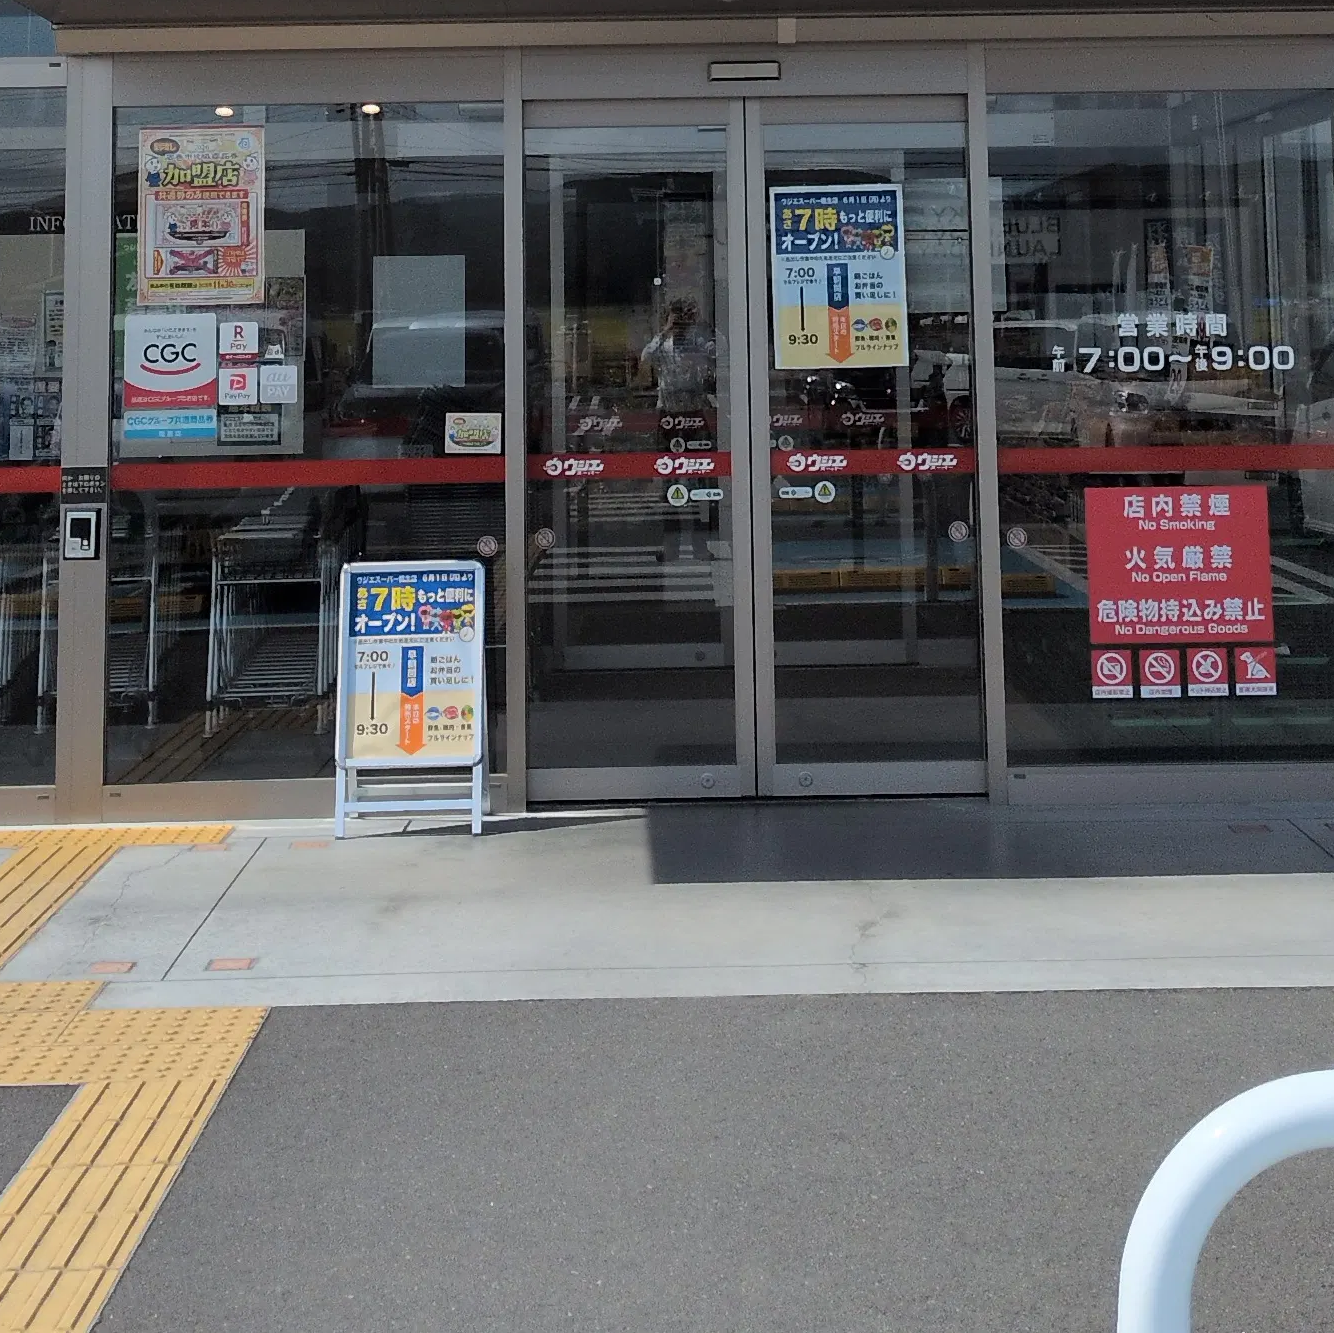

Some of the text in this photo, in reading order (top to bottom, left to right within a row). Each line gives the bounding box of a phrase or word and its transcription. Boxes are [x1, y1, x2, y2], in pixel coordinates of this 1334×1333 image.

[160, 160, 241, 187] 加盟店
[839, 209, 893, 224] もっと便利に
[785, 267, 815, 278] 7:00
[1117, 313, 1228, 338] 営業時間
[230, 342, 248, 350] Pay
[788, 334, 819, 345] 9:30
[143, 342, 197, 363] CGC
[224, 392, 251, 400] PayPay
[267, 386, 291, 398] PAY
[1123, 493, 1231, 518] 店内禁煙
[1139, 519, 1215, 531] No Smoking
[1125, 545, 1233, 569] 火気厳禁
[1131, 571, 1227, 584] No Open Flame
[1097, 597, 1265, 622] 危険物持込み禁止
[1115, 623, 1248, 636] No Dangerous Goods
[357, 651, 389, 662] 7:00
[356, 723, 389, 735] 9:30
